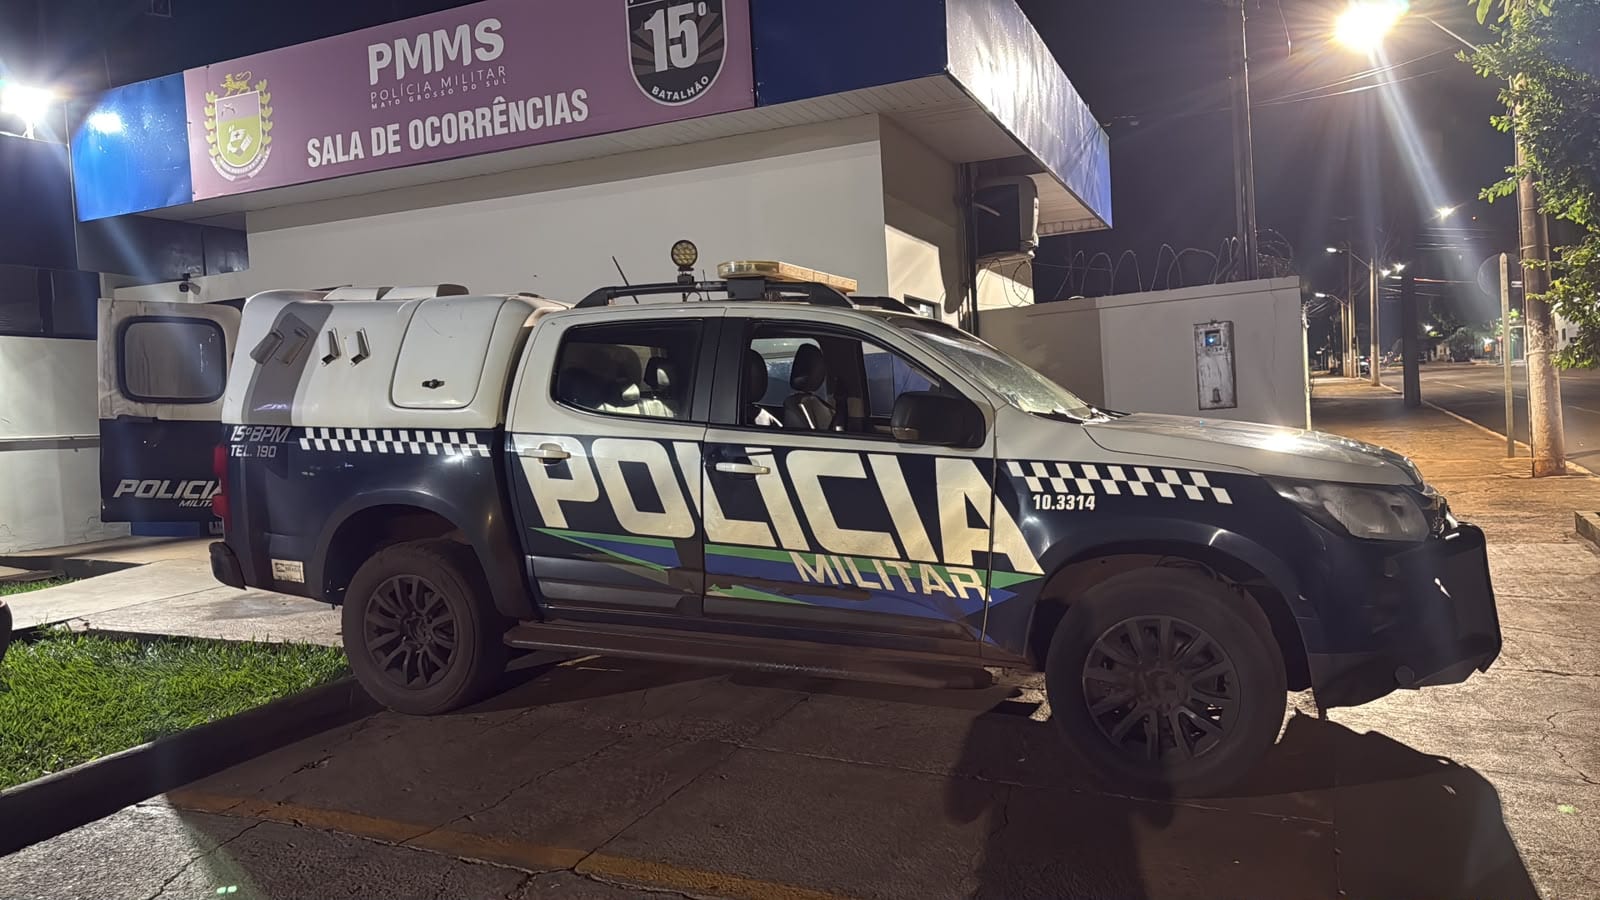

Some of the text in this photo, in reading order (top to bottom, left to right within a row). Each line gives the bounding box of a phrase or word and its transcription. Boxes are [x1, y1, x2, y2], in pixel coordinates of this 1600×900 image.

[368, 18, 504, 86] PMMS
[370, 65, 506, 103] POLÍCIA MILITAR
[371, 78, 506, 110] MATO GROSSO DO SUL
[651, 75, 709, 101] BATALHÃO
[307, 88, 589, 168] SALA DE OCORRÊNCIAS
[230, 444, 277, 458] TEL. 190
[1033, 494, 1096, 510] 10.3314
[788, 552, 992, 602] MILITAR
